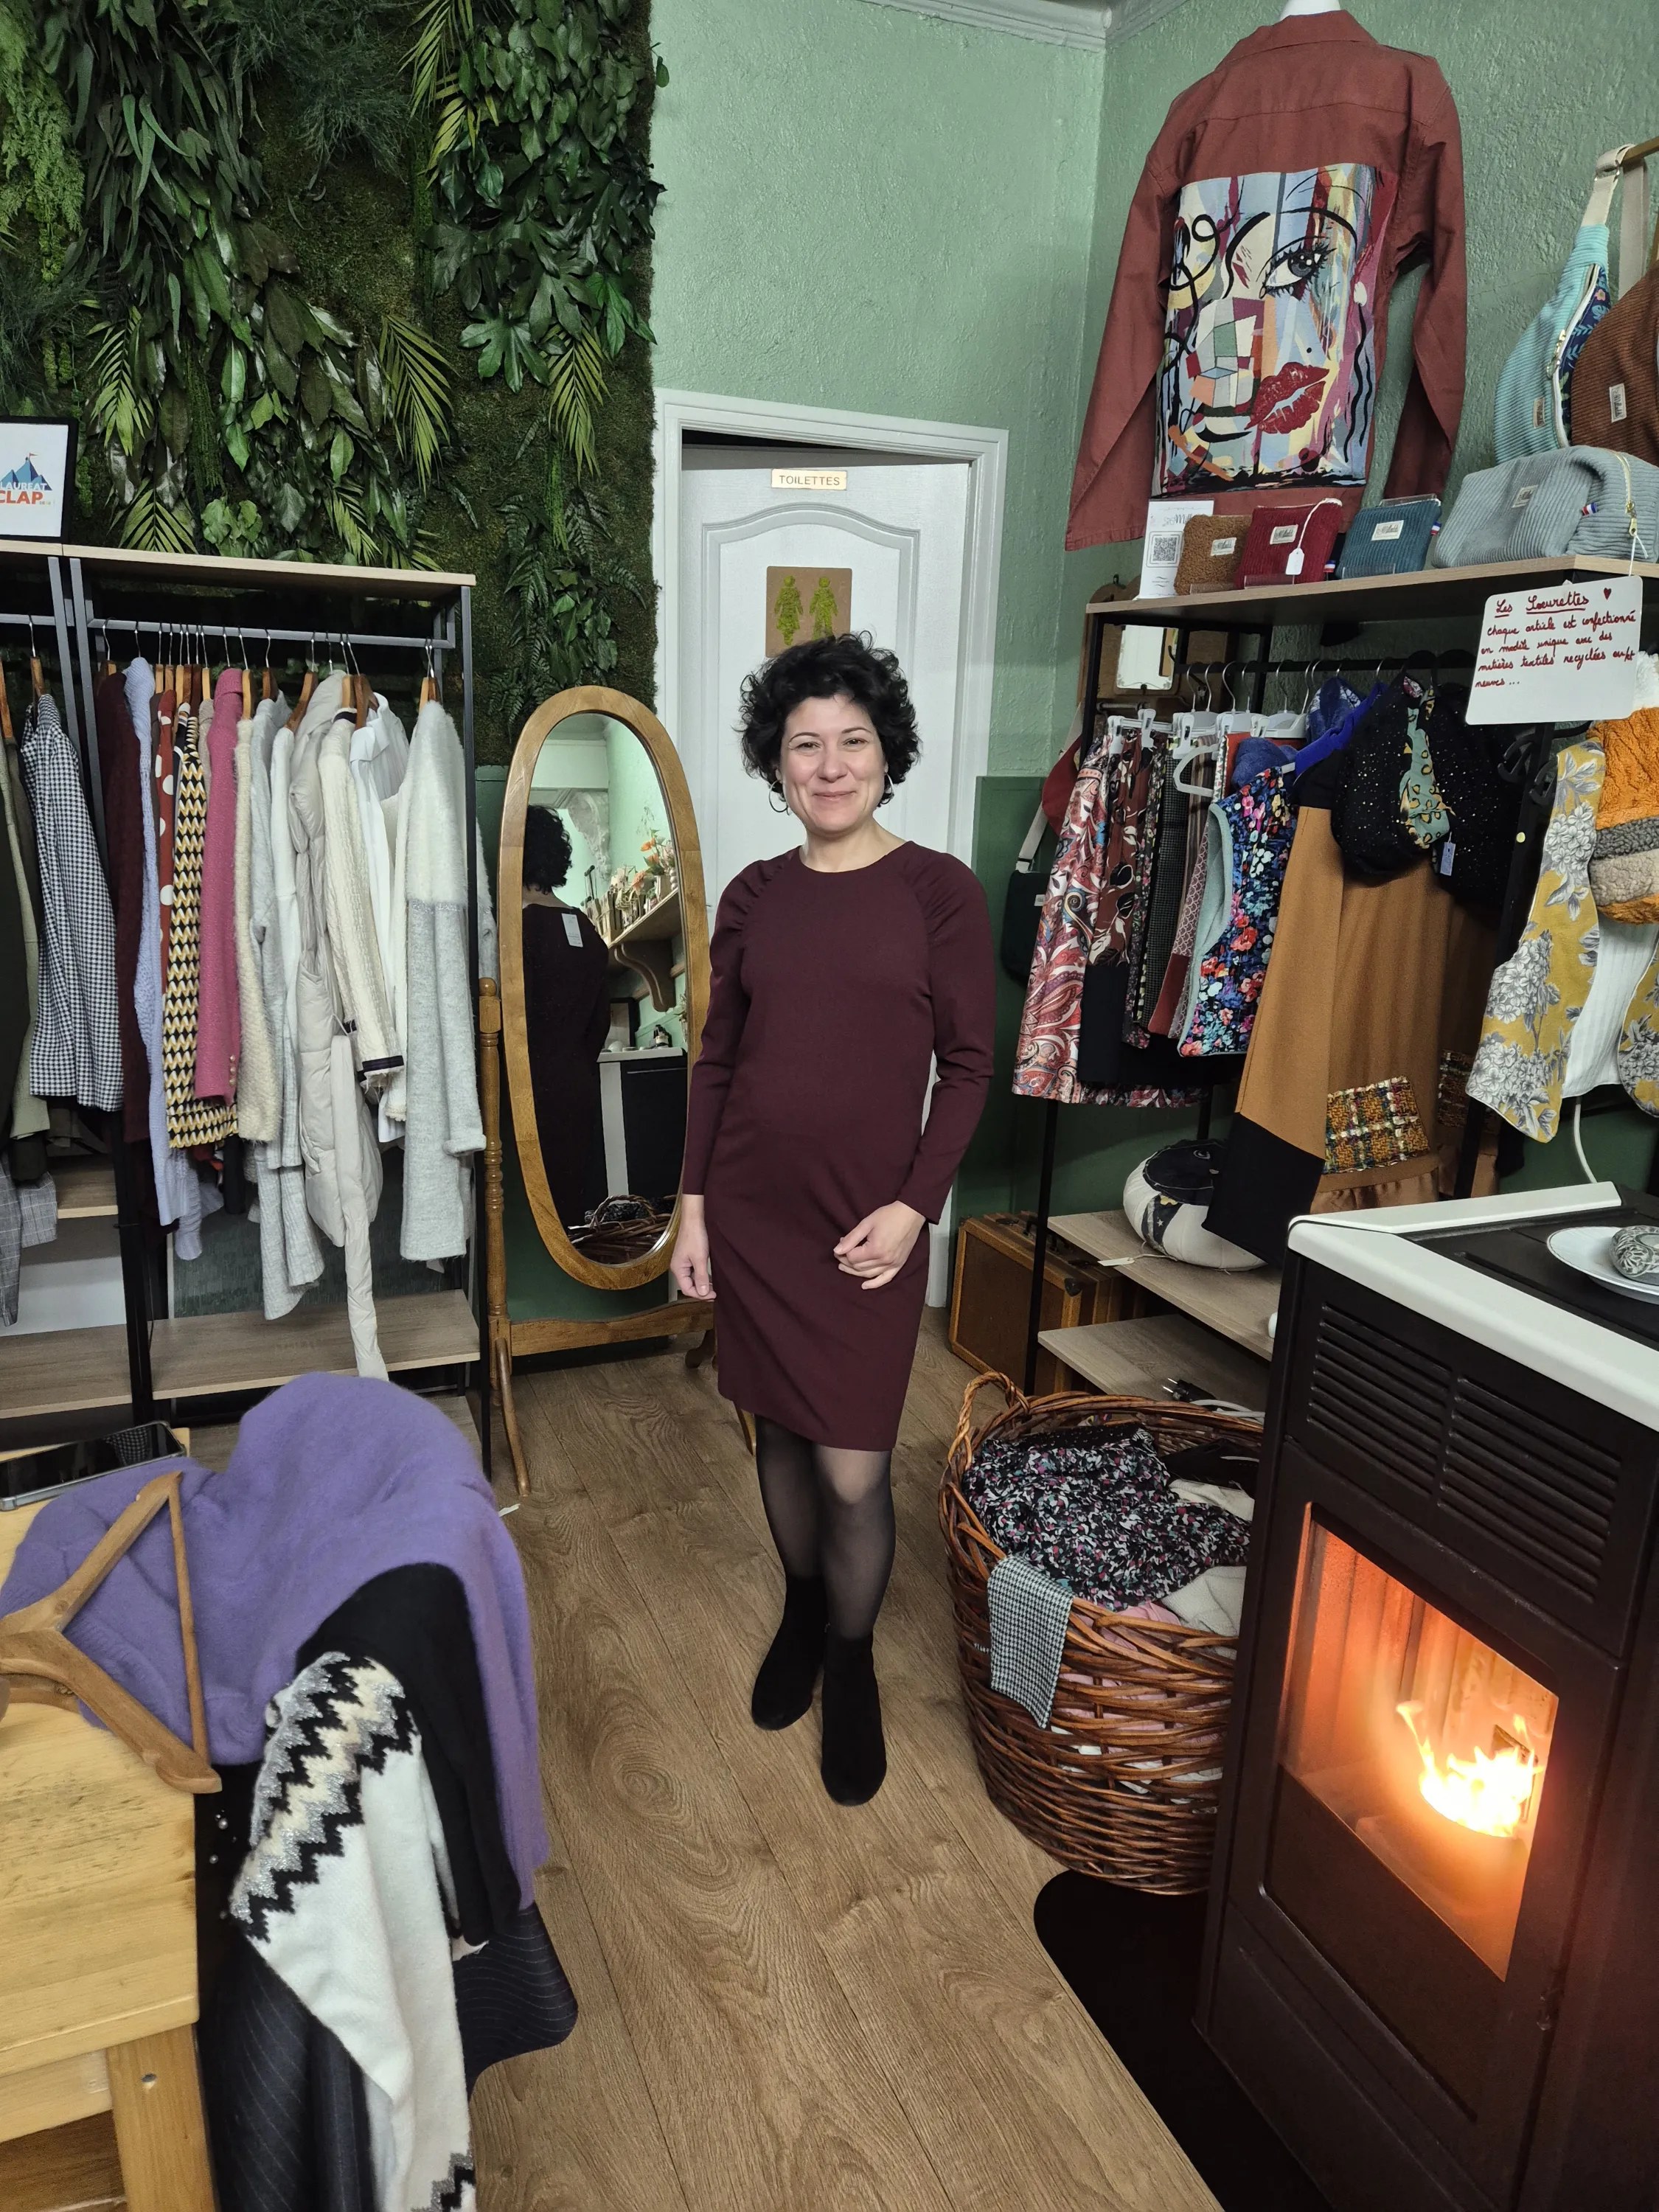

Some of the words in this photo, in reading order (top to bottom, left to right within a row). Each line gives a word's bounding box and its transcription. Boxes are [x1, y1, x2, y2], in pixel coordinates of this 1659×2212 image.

[1, 481, 48, 491] LAUREAT
[779, 476, 840, 486] TOILETTES
[1495, 599, 1513, 613] Les
[1526, 616, 1556, 633] article
[1563, 614, 1577, 629] est
[1537, 638, 1569, 658] unique
[1576, 636, 1593, 645] avec
[1599, 630, 1613, 641] des
[1520, 653, 1554, 667] textiles
[1563, 647, 1606, 671] recyclées
